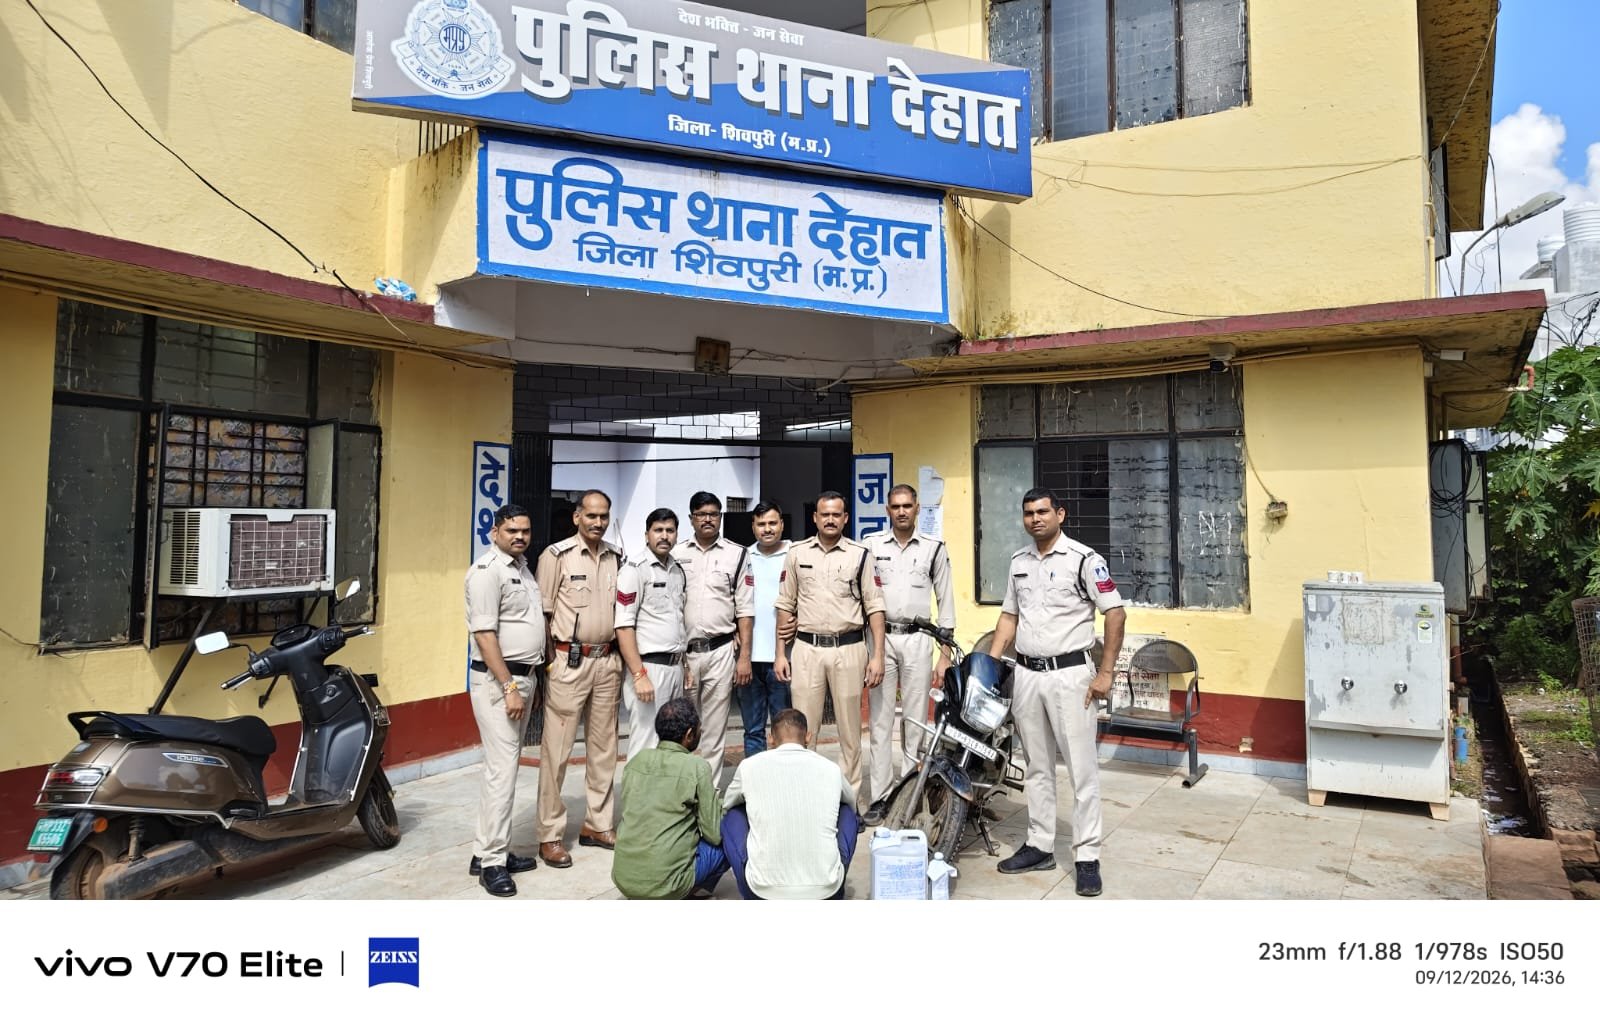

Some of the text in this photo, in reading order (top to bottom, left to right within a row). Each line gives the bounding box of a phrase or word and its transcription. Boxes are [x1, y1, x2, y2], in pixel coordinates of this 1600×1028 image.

[678, 7, 701, 26] देश
[704, 16, 740, 34] भक्ति
[752, 25, 776, 41] जन
[779, 28, 804, 46] सेवा
[511, 0, 1021, 149] पुलिस थाना देहात
[721, 122, 777, 149] शिवपुरी
[780, 131, 831, 158] (म.प्र.)
[496, 157, 932, 266] पुलिस थाना देहात
[573, 231, 887, 299] जिला शिवपुरी (म.प्र.)
